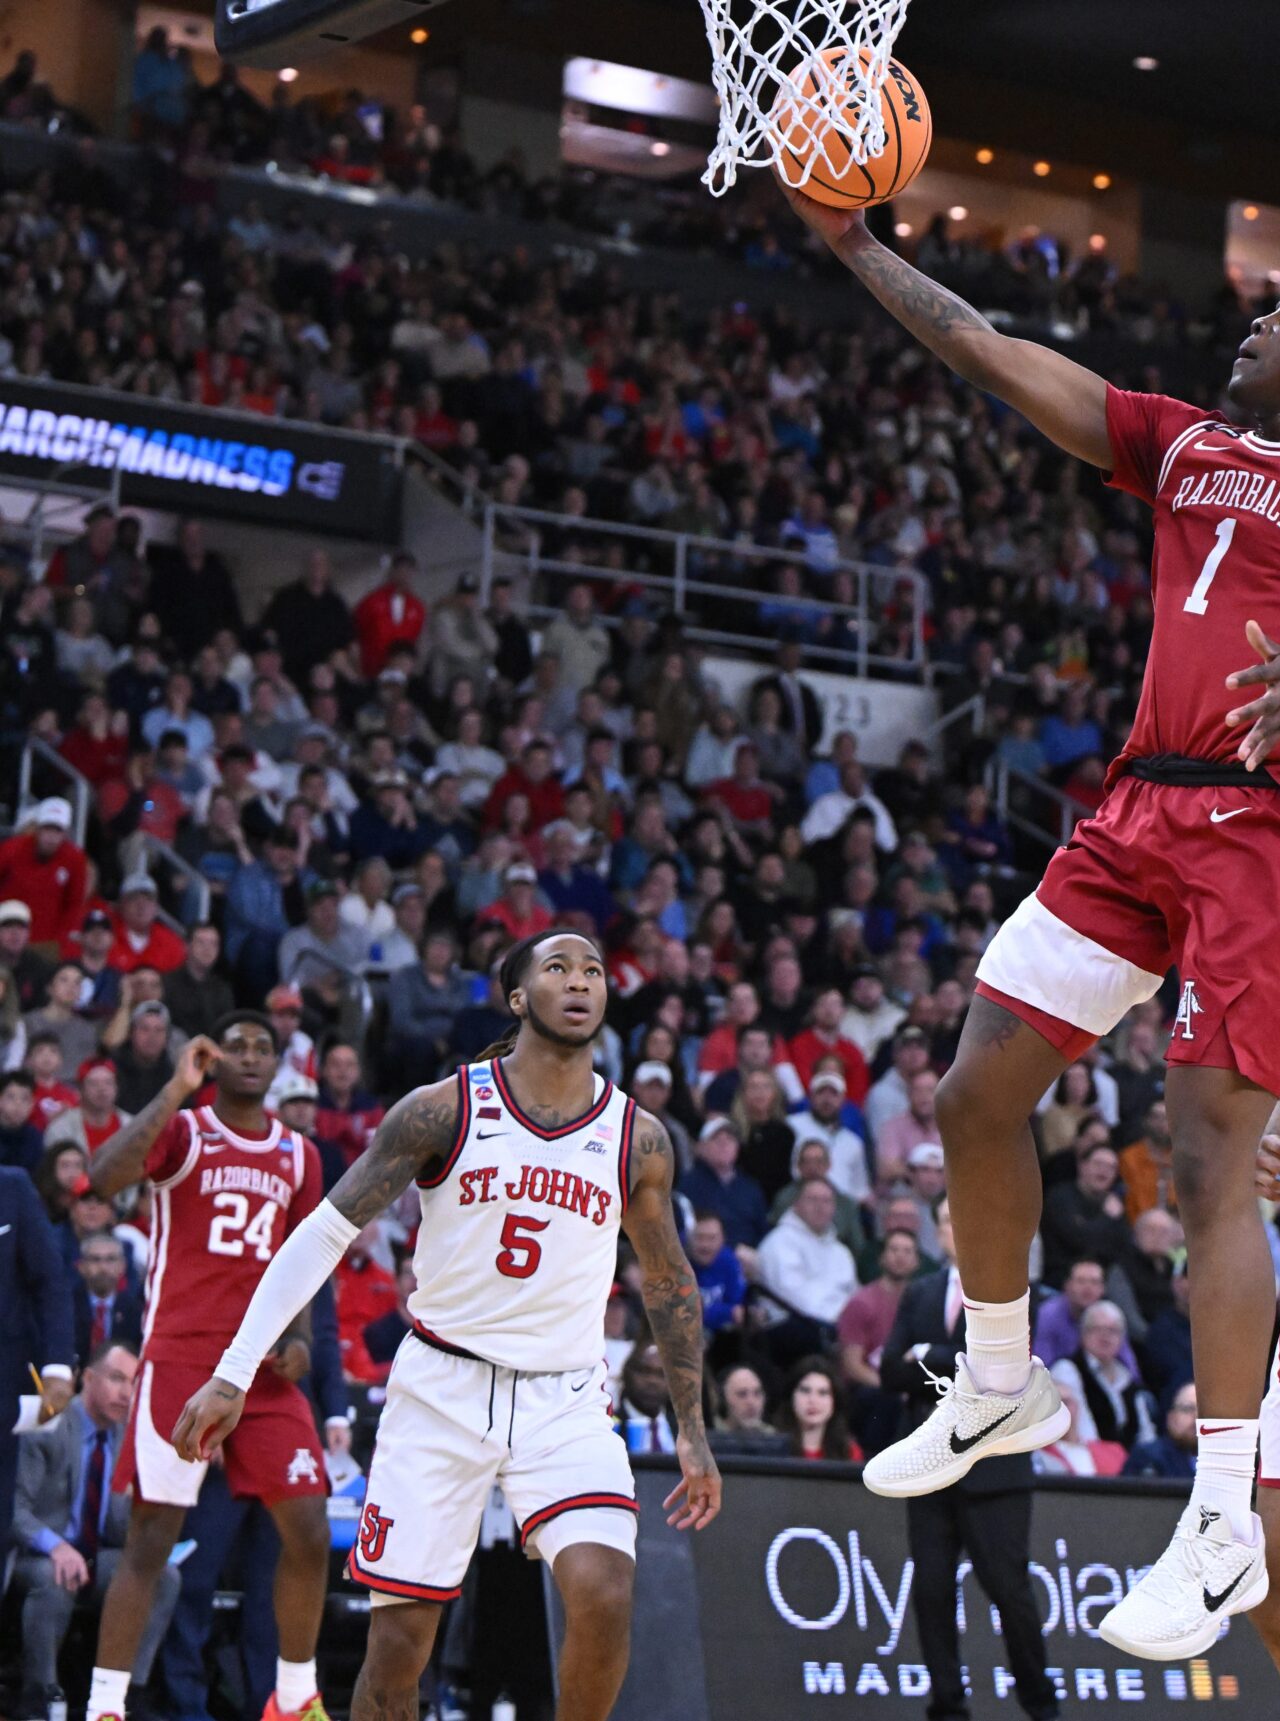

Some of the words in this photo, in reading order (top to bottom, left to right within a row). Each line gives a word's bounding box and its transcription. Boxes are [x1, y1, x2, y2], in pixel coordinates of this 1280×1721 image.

[887, 60, 921, 122] NCA
[0, 403, 110, 468] ARCH
[111, 423, 296, 497] MADNESS
[1183, 517, 1237, 616] 1
[208, 1192, 272, 1261] 24
[458, 1167, 499, 1206] ST.
[504, 1165, 613, 1227] JOHN'S
[495, 1213, 552, 1280] 5
[803, 1661, 972, 1697] MAD
